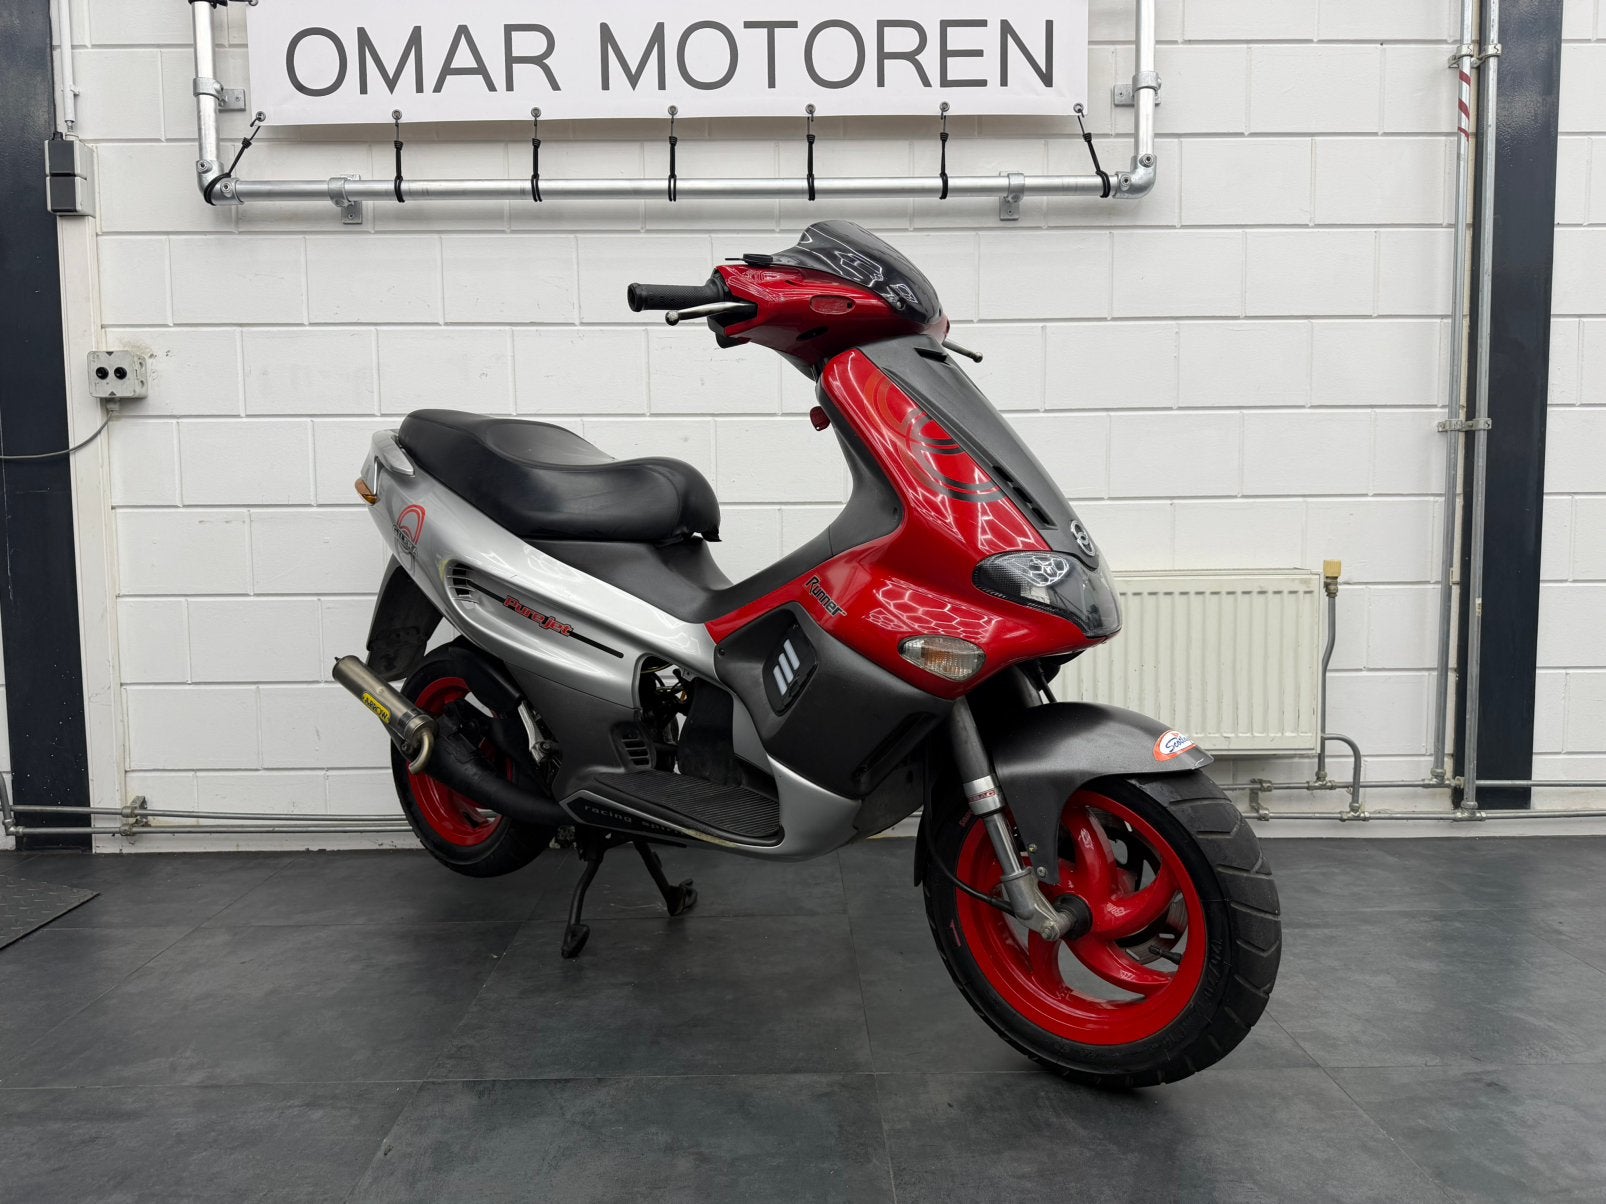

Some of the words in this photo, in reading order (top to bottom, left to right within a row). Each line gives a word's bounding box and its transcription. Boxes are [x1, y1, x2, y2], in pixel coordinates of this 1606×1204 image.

[286, 24, 562, 97] OMAR
[600, 19, 1054, 91] MOTOREN
[804, 575, 848, 617] Runner
[584, 804, 632, 824] racing
